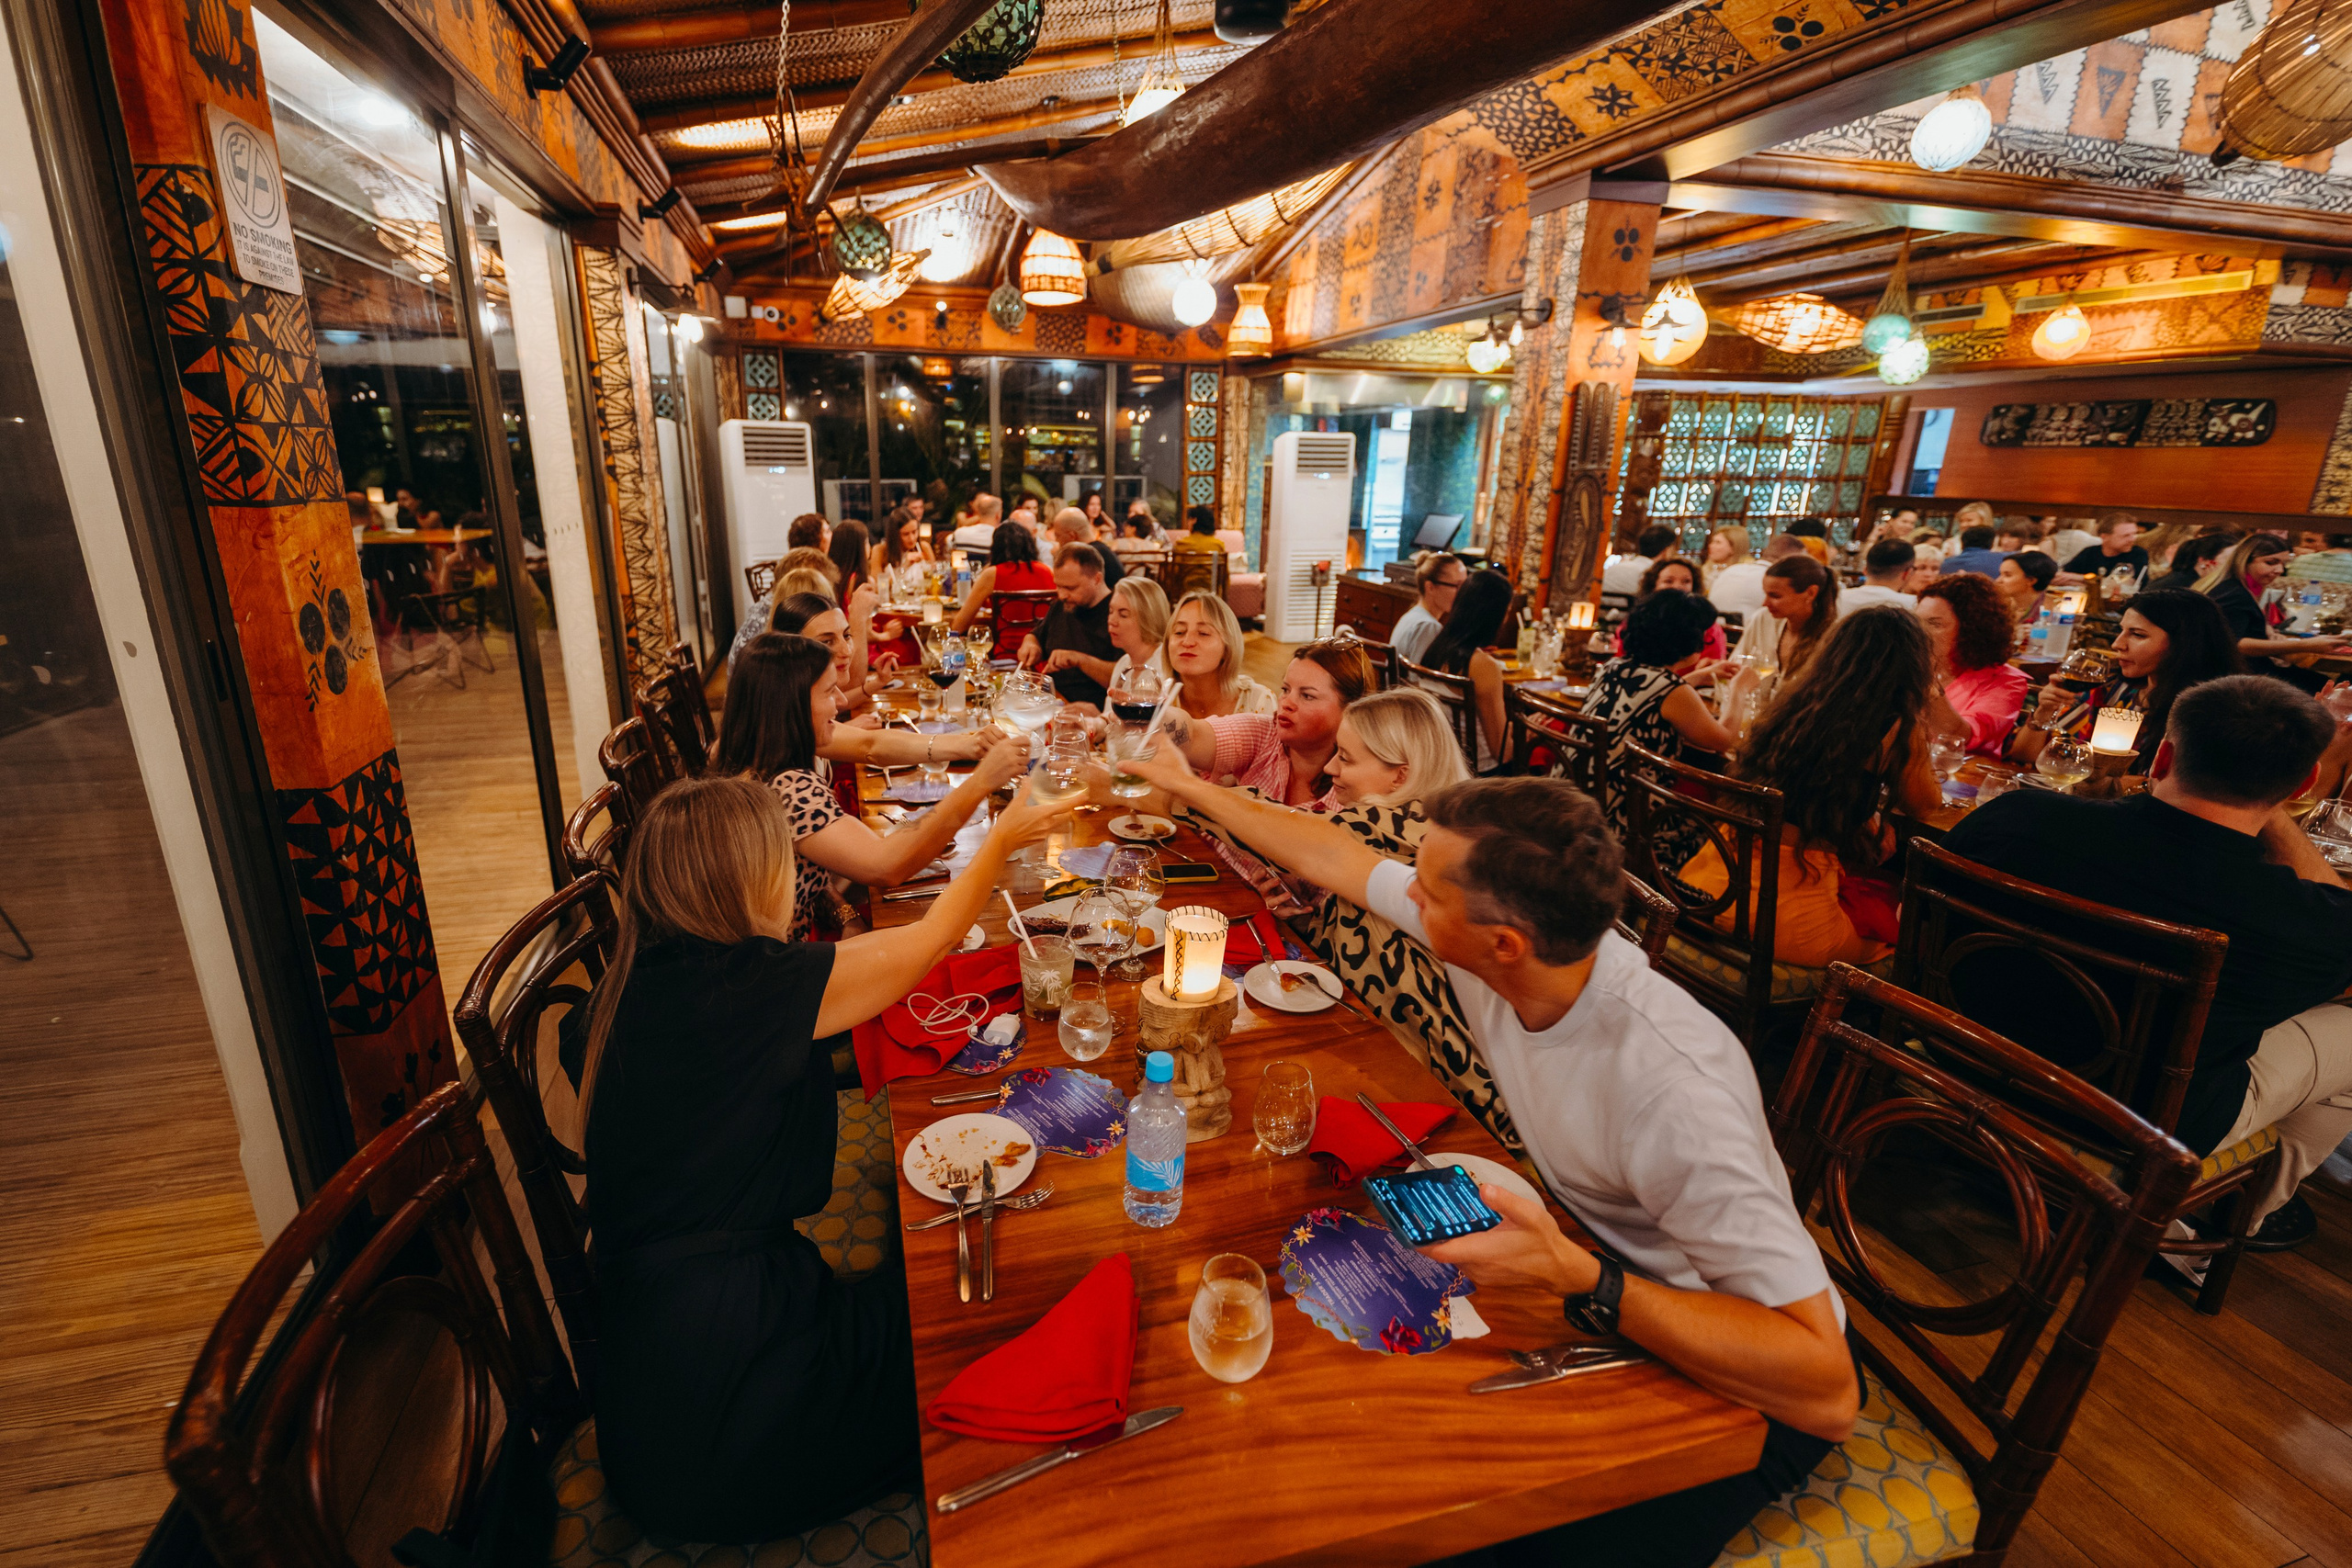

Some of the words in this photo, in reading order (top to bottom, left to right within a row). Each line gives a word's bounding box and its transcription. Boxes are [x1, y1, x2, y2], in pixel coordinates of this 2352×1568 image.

[232, 221, 249, 239] NO
[250, 228, 292, 254] SMOKING
[236, 239, 243, 249] IT
[243, 241, 250, 252] IS
[250, 243, 272, 258] AGAINST
[272, 251, 283, 263] THE
[243, 253, 251, 264] TO
[251, 255, 270, 270] SMOKE
[270, 262, 278, 272] ON
[278, 265, 294, 278] THESE
[258, 269, 285, 286] PREMISES
[1307, 1272, 1317, 1282] VIC
